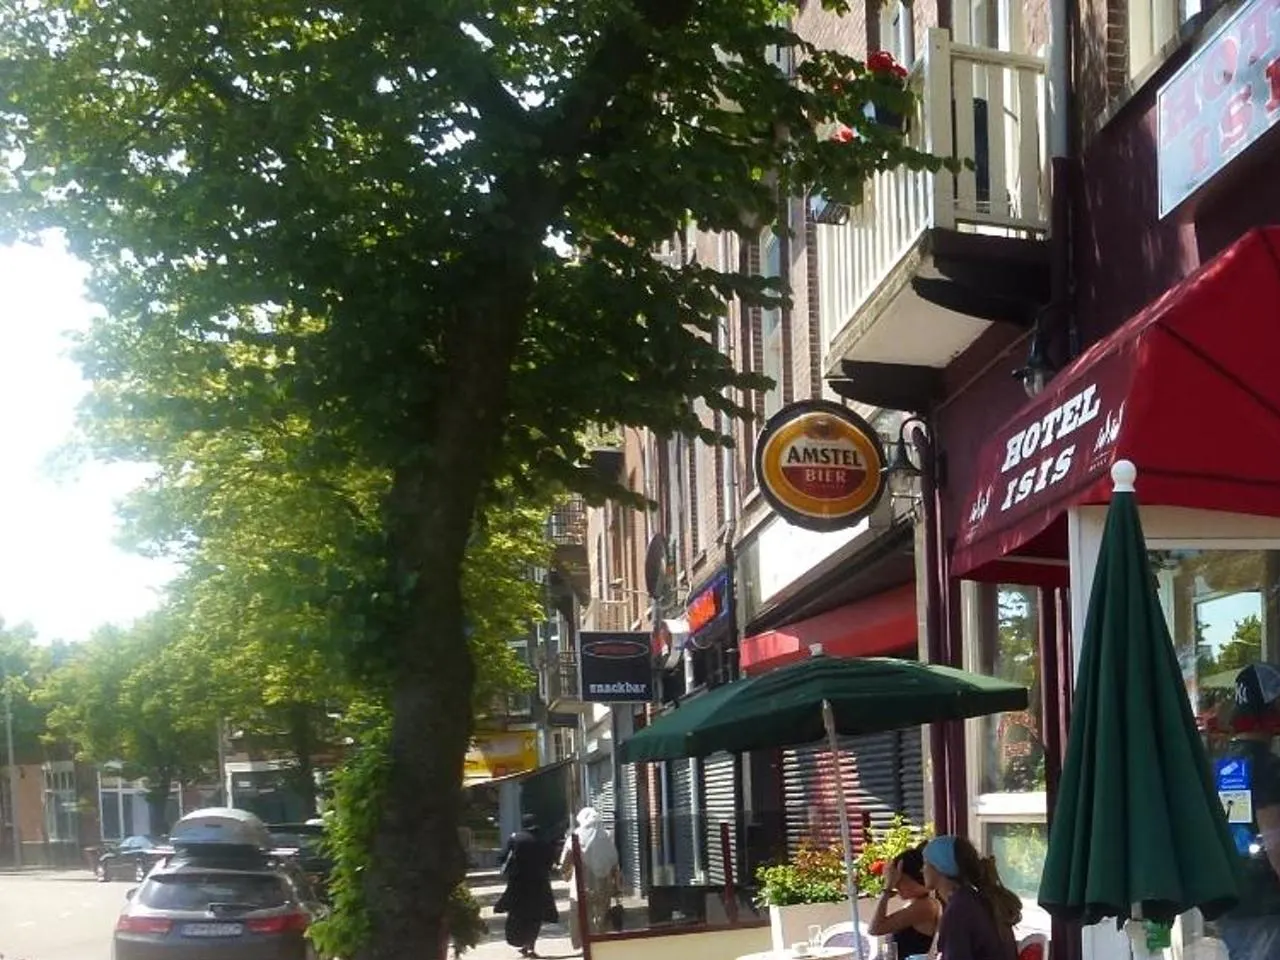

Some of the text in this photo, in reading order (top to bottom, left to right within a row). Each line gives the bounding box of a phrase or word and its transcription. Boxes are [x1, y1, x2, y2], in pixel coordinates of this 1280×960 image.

[1001, 383, 1101, 473] HOTEL
[787, 446, 862, 467] AMSTEL
[806, 468, 847, 484] BIER
[1001, 444, 1077, 512] ISIS
[589, 682, 647, 694] snackbar
